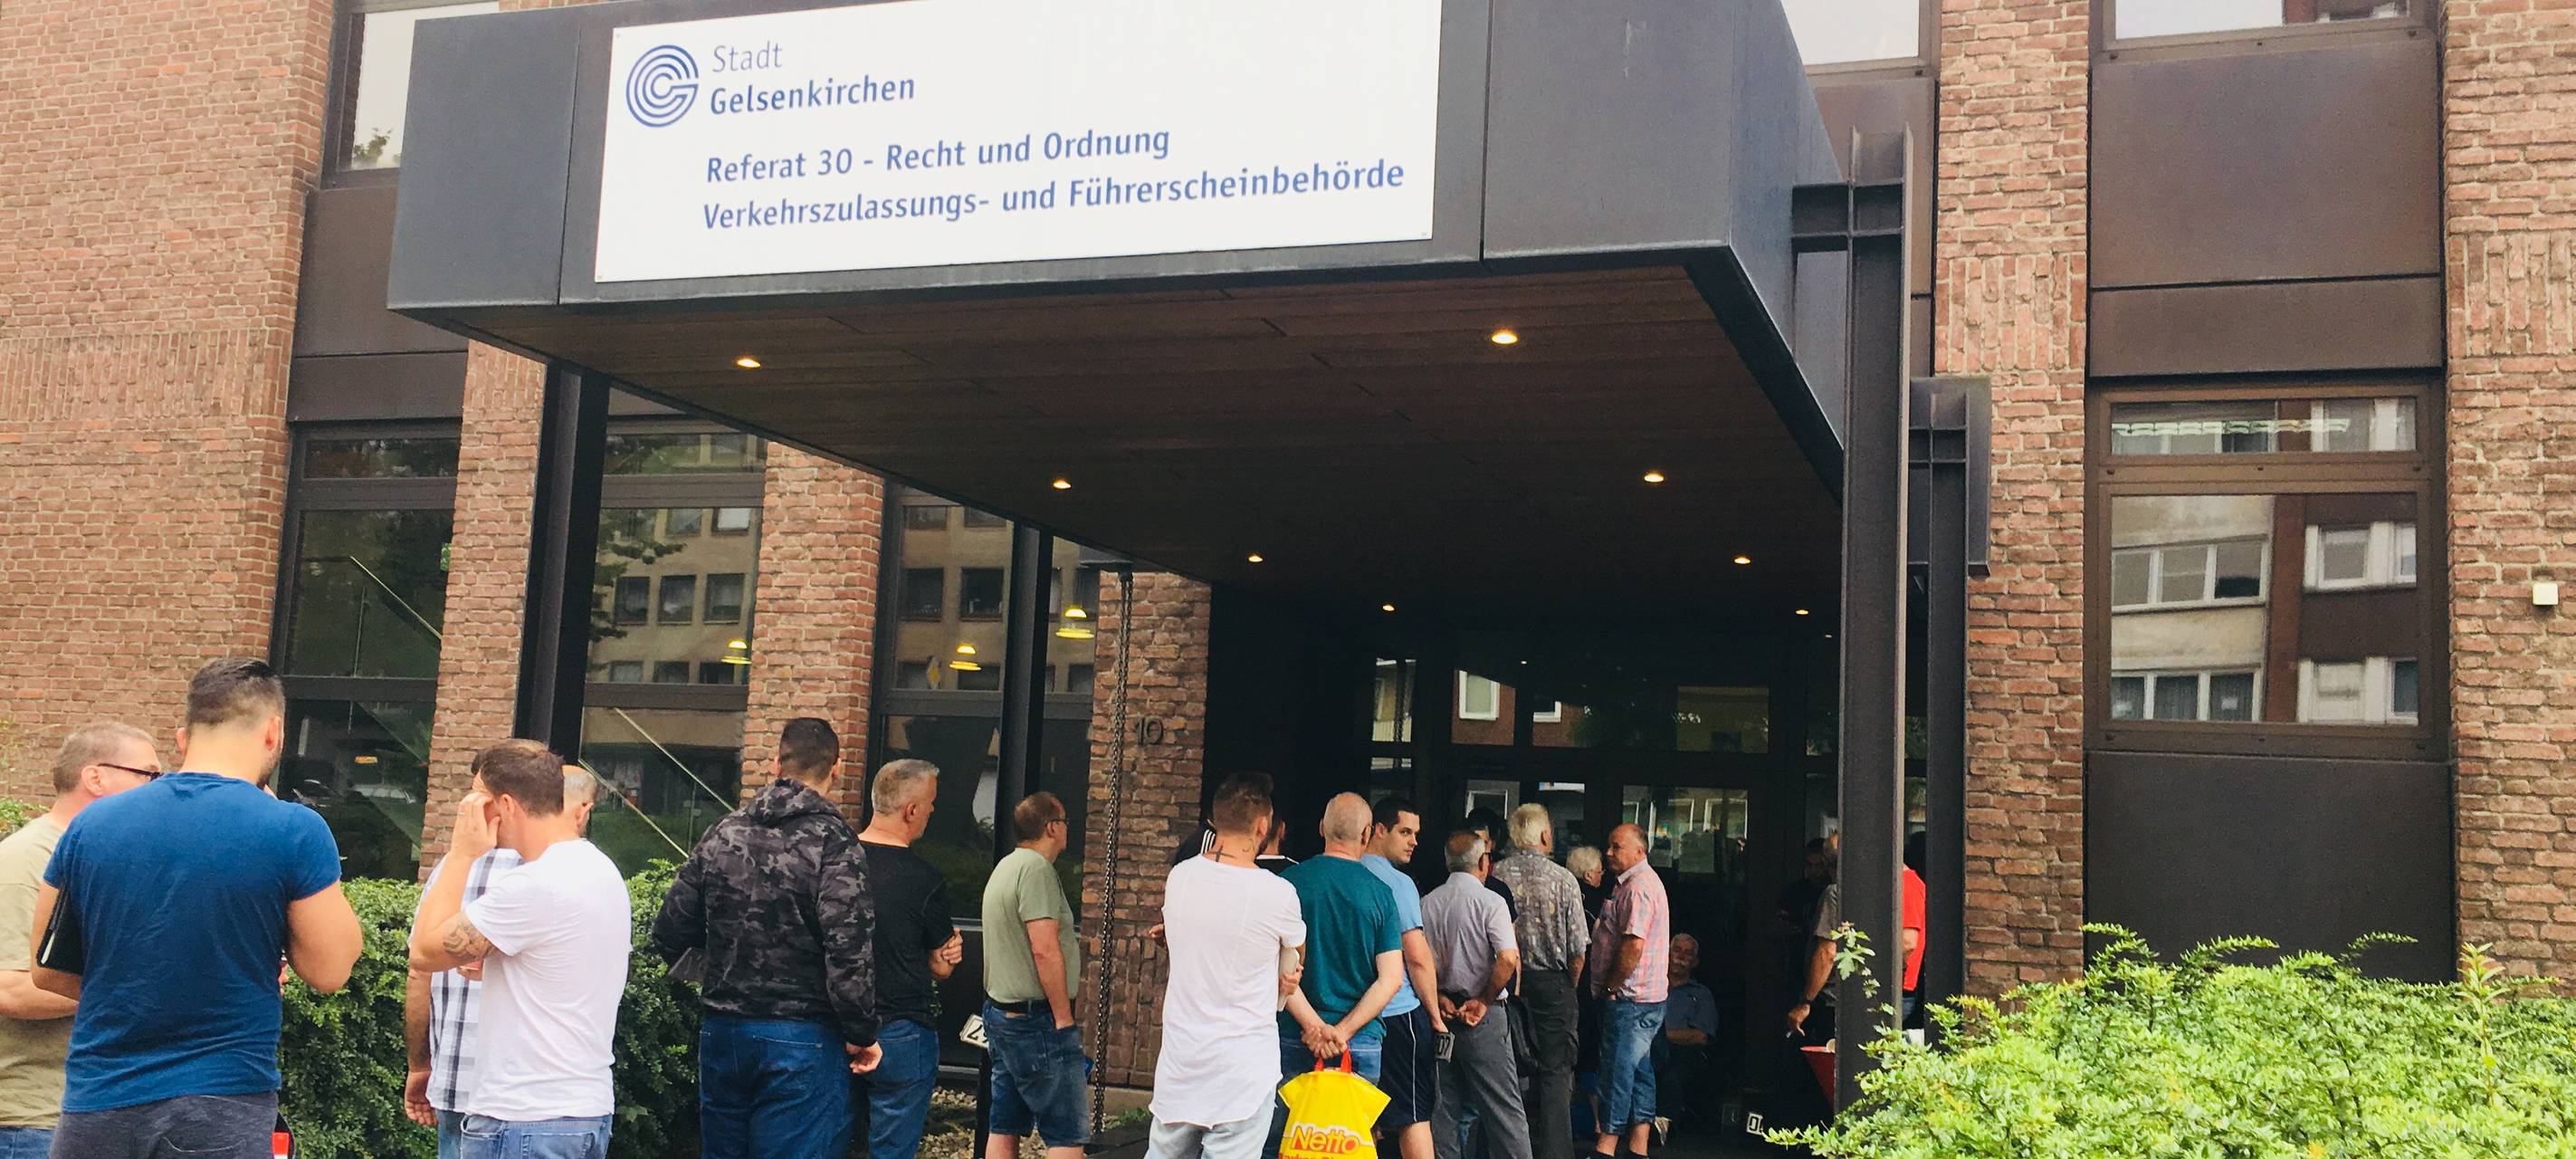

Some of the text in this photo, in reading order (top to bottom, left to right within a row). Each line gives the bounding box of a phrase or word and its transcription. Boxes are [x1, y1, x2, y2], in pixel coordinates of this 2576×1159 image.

[711, 42, 784, 74] Stadt
[709, 73, 915, 117] Gelsenkirchen
[705, 152, 806, 183] Referat
[816, 145, 854, 176] 30
[884, 139, 966, 170] Recht
[976, 132, 1030, 166] und
[1042, 129, 1171, 160] Ordnung
[702, 158, 1406, 230] Verkehrszulassungs- und Führerscheinbehörde
[1135, 715, 1163, 746] 10
[1291, 1125, 1360, 1154] Netto
